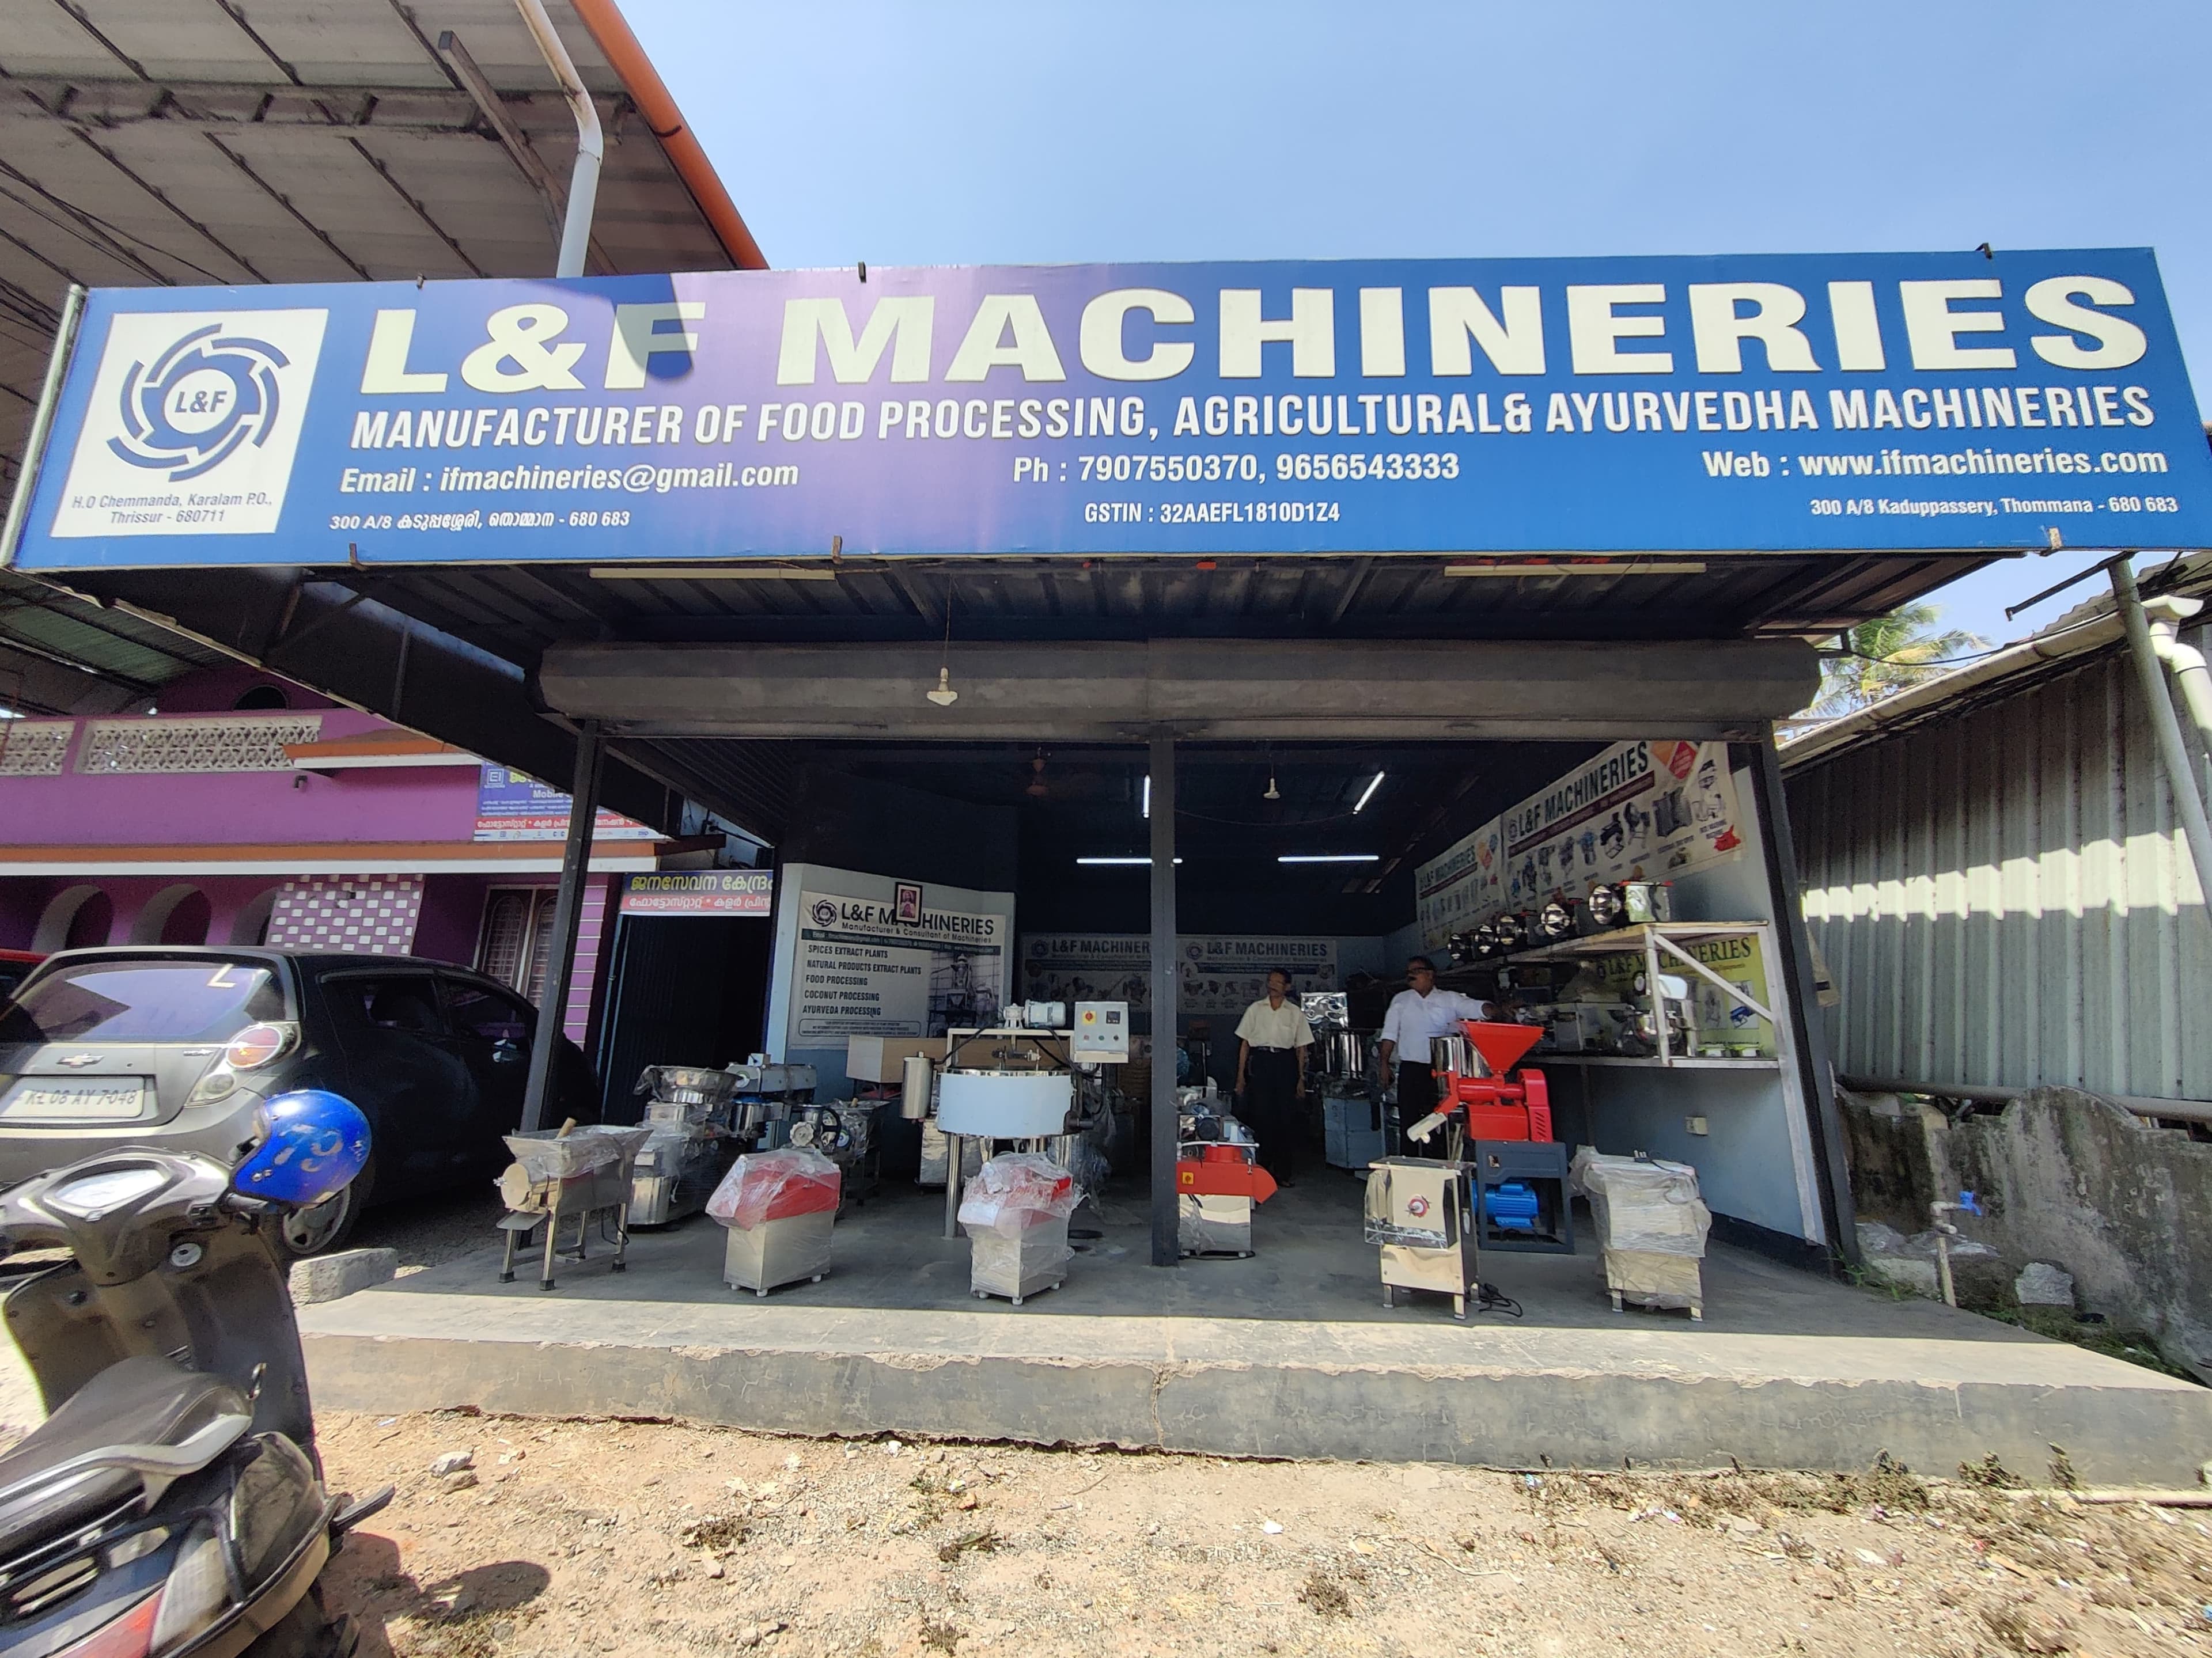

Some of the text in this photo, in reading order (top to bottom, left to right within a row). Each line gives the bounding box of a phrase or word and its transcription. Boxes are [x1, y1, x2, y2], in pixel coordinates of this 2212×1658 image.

[361, 276, 2147, 394] L&F MACHINERIES
[175, 390, 227, 412] L&F
[350, 405, 681, 449] MANUFACTURER
[695, 404, 746, 445] OF
[756, 401, 864, 443] FOOD
[878, 396, 1158, 441] PROCESSING,
[1546, 389, 1819, 433] AYURVEDHA
[1832, 386, 2154, 431] MACHINERIES
[1014, 457, 1048, 483] Ph
[1079, 454, 1265, 484] 7907550370,
[1277, 453, 1460, 481] 9656543333
[1703, 450, 1769, 477] Web
[1798, 447, 2168, 476] www.ifmachineries.com
[340, 467, 415, 493] Email
[440, 462, 798, 494] ifmachineries@gmail.com
[72, 495, 95, 509] H.O
[100, 494, 183, 507] Chemmanda,
[188, 492, 242, 506] Karalam
[1810, 499, 1842, 515] 300
[1846, 499, 1874, 515] A/8
[1878, 499, 1998, 517] Kaduppassery,
[2001, 498, 2093, 514] Thommana
[2108, 498, 2141, 512] 680
[2146, 497, 2178, 513] 683
[111, 510, 163, 523] Thrissur
[176, 510, 225, 523] 680711
[330, 515, 359, 530] 300
[363, 515, 392, 529] A/8
[569, 511, 597, 526] 680
[601, 511, 630, 526] 683
[1085, 503, 1141, 522] GSTIN
[1161, 502, 1340, 523] 32AAEFL1810D1Z4
[1518, 804, 1540, 836] L&F
[1544, 741, 1648, 824] MACHINERIES
[842, 903, 994, 935] L&F MHINERIES
[842, 922, 893, 933] Manufacturer
[904, 928, 941, 939] Consultant
[952, 934, 991, 943] Machineries
[808, 945, 888, 958] SPICES EXTRACT PLANTS
[1081, 940, 1150, 954] MACHINER
[1207, 942, 1327, 957] L&F MACHINERIES
[807, 959, 922, 975] NATURAL PRODUCTS EXTRACT PLANTS
[806, 974, 868, 985] FOOD PROCESSING
[804, 990, 880, 1001] COCONUT PROCESSING
[802, 1005, 881, 1016] AYURVEDA PROCESSING
